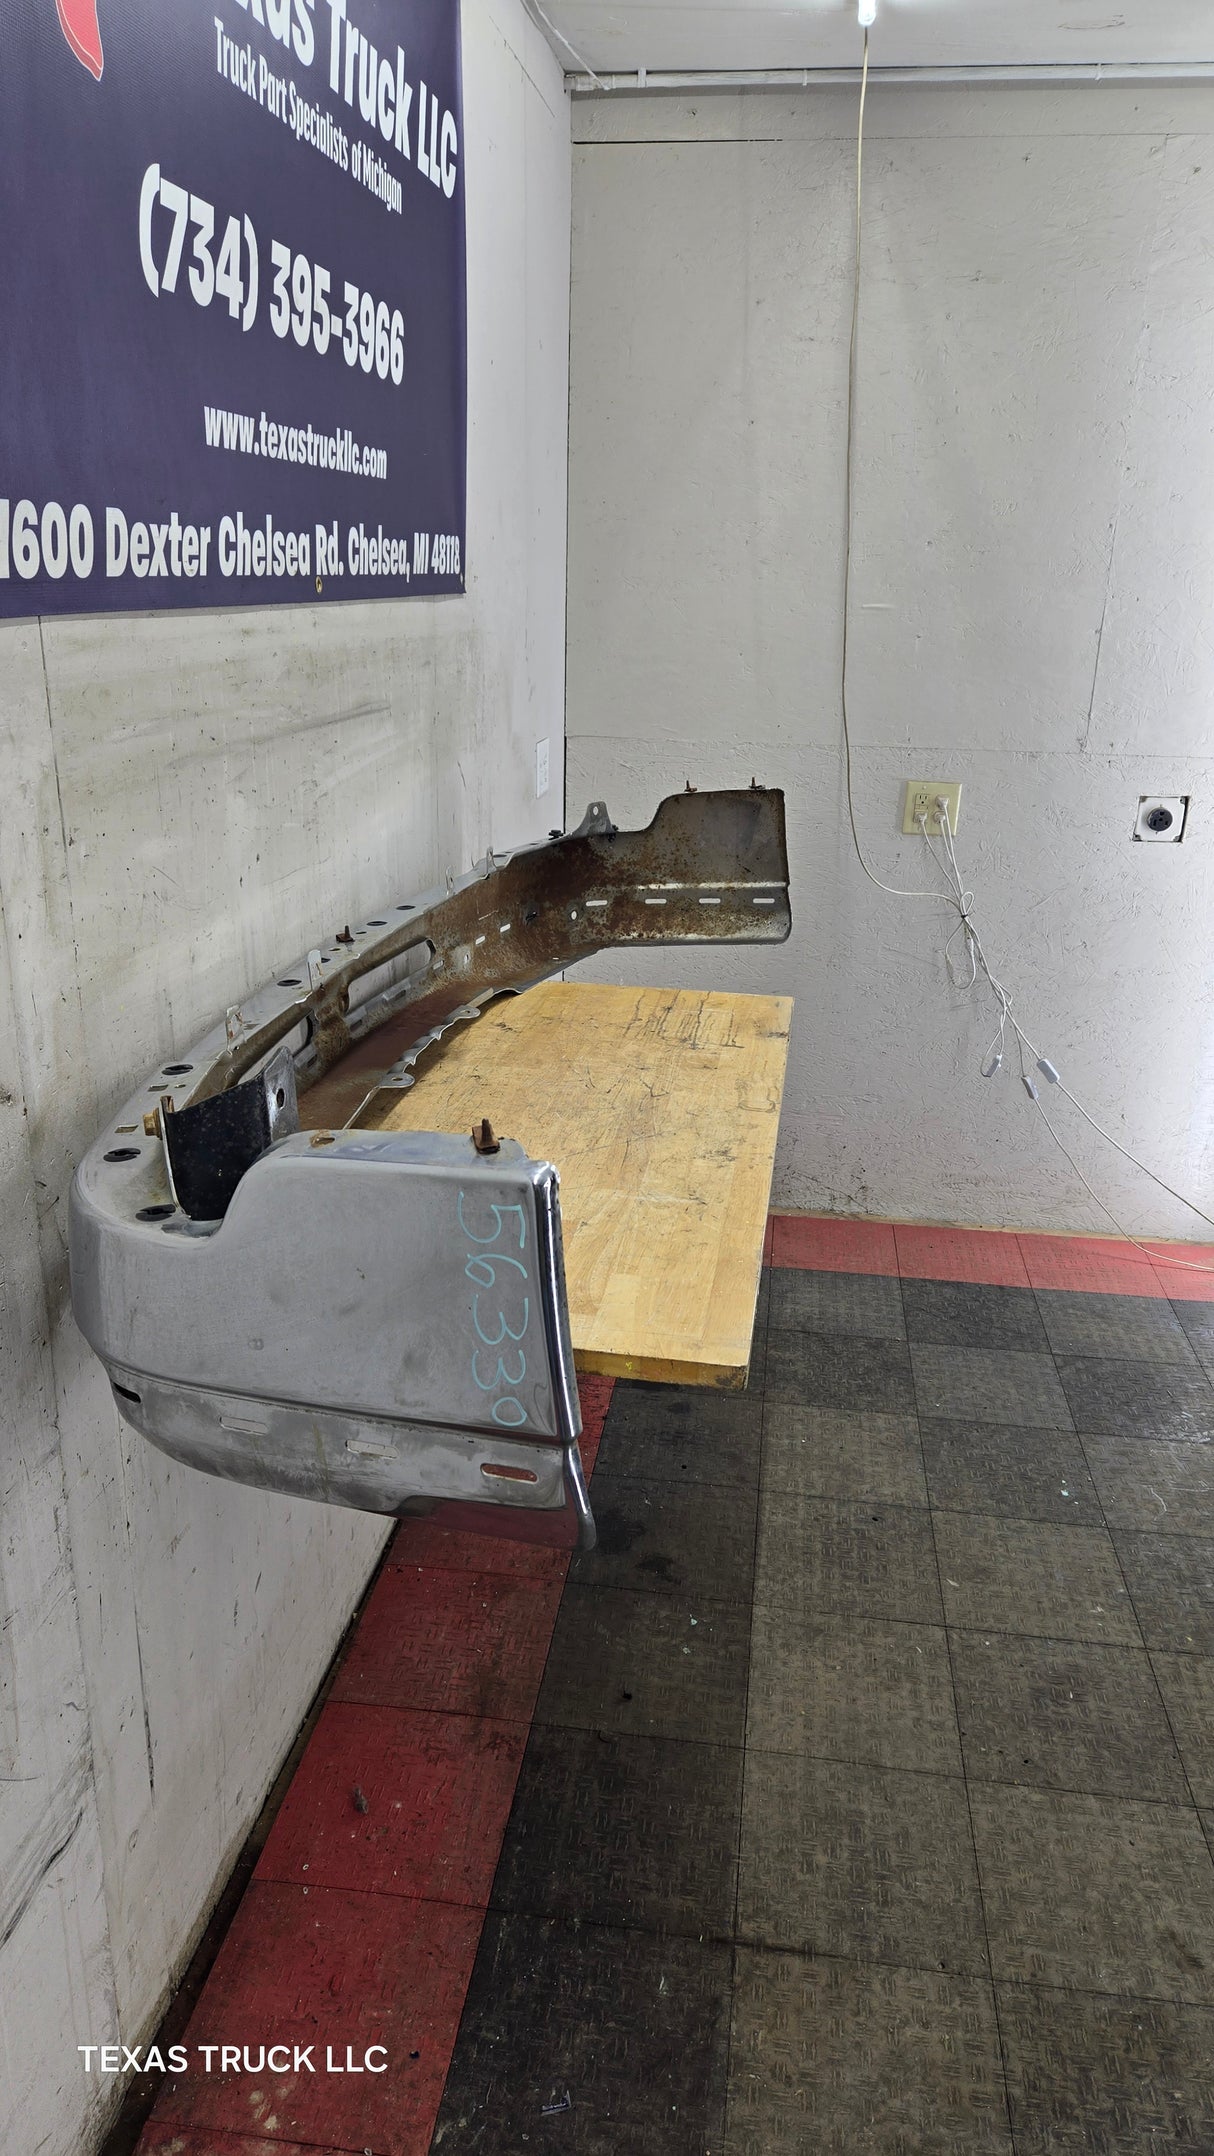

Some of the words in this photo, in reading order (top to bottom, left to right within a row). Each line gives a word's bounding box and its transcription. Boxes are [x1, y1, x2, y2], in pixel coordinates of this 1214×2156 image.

[214, 16, 257, 100] Truck
[259, 54, 288, 124] Part
[289, 80, 349, 172] Specialists
[351, 140, 363, 182] of
[363, 143, 403, 215] Michigan
[325, 0, 414, 161] Truck
[417, 80, 458, 199] LLC
[139, 163, 259, 332] (734)
[270, 239, 405, 386] 395-3966
[204, 405, 388, 480] www.texastruckllc.com
[106, 507, 212, 577] Dexter
[218, 511, 311, 577] Chelsea
[315, 520, 344, 577] Rd.
[347, 523, 410, 583] Chelsea,
[413, 532, 430, 575] MI
[431, 535, 461, 575] 48118
[457, 1191, 529, 1427] 56330
